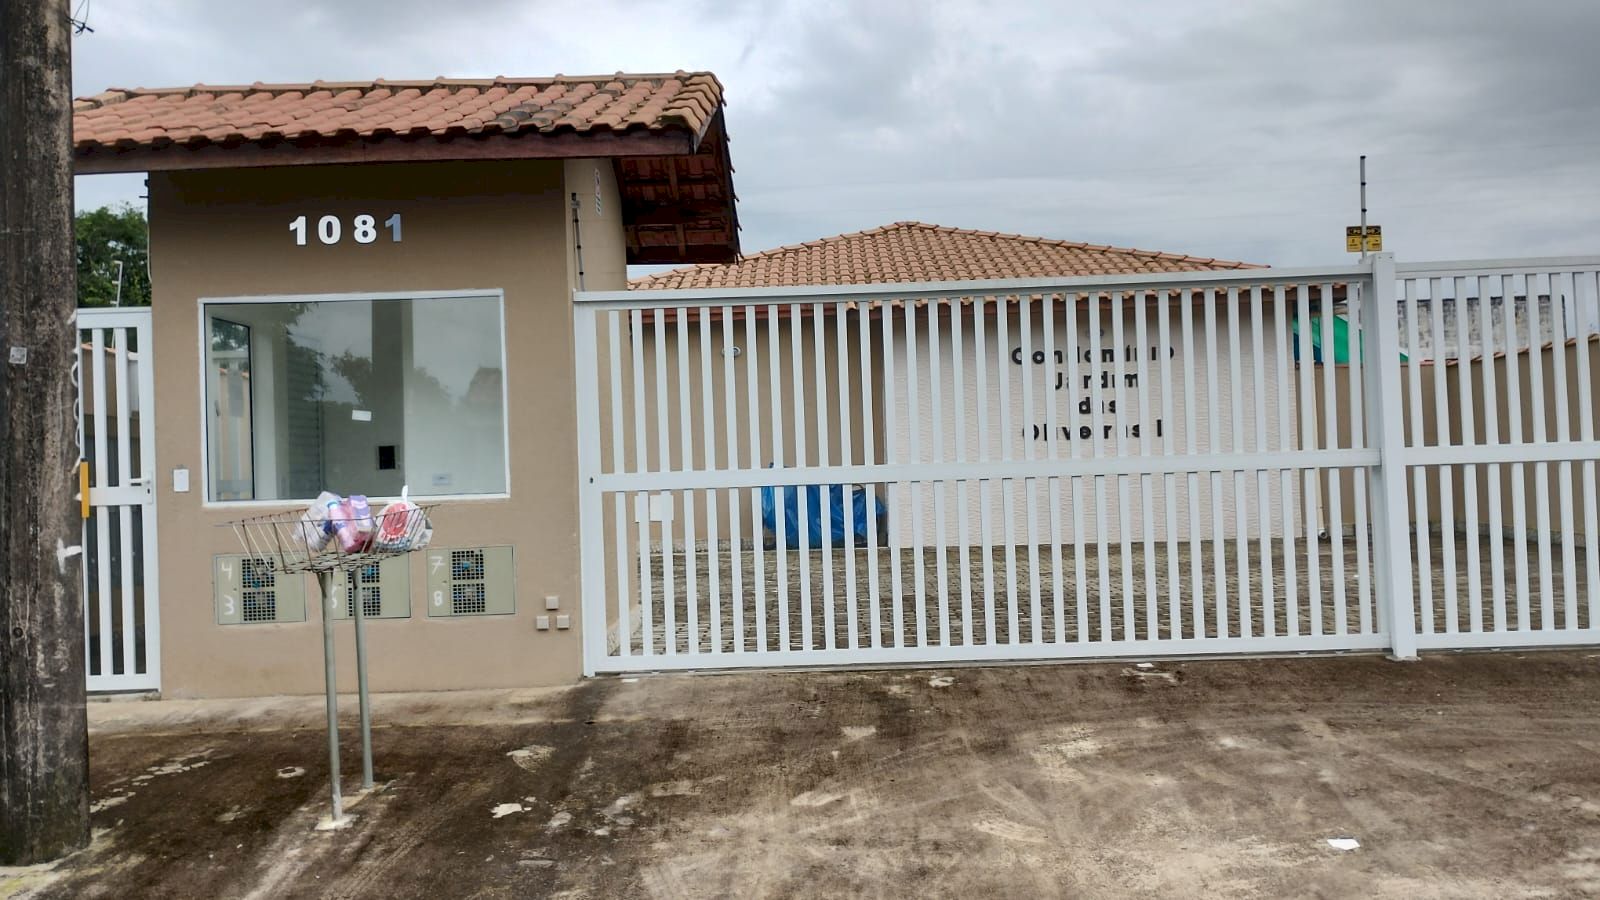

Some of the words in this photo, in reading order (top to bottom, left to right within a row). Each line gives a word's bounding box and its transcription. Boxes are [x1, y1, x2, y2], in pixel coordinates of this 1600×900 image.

[289, 213, 402, 245] 1081
[1055, 370, 1144, 390] Jrdim
[1079, 396, 1118, 414] ds
[221, 561, 232, 581] 4
[431, 556, 445, 575] 7
[224, 594, 234, 615] 3
[434, 590, 443, 606] 8
